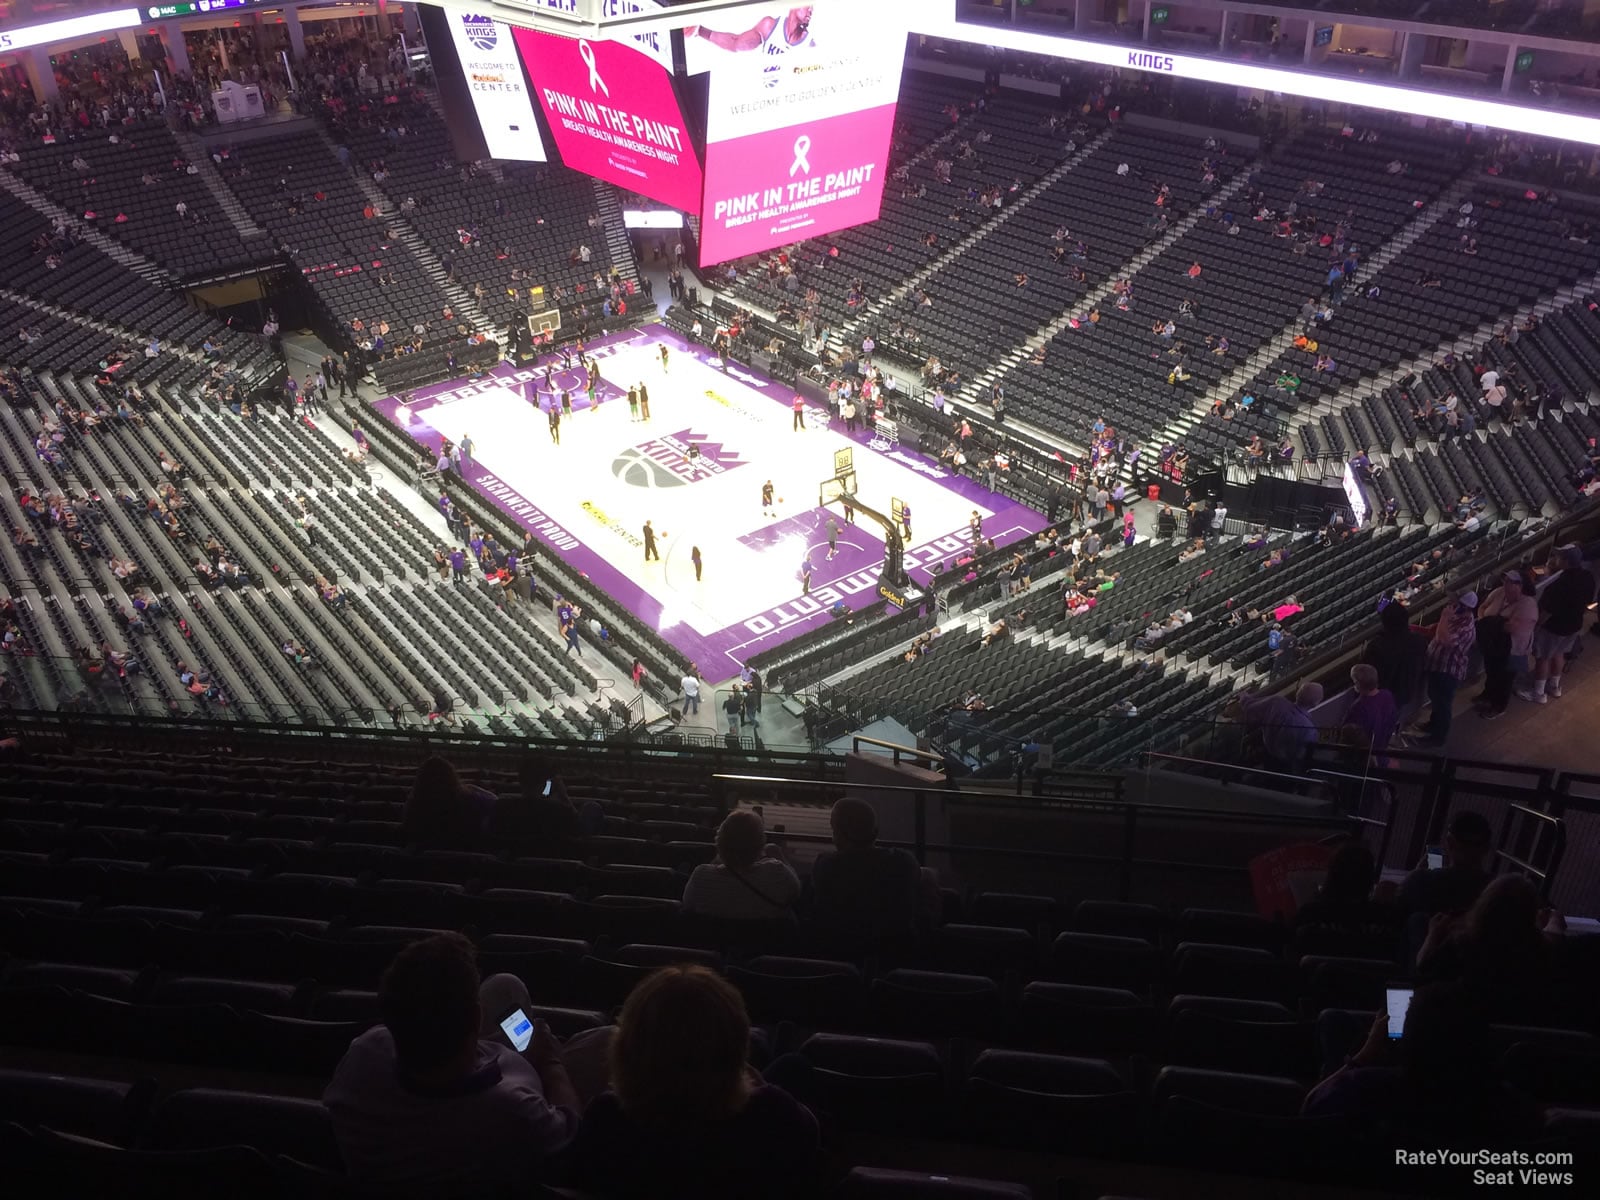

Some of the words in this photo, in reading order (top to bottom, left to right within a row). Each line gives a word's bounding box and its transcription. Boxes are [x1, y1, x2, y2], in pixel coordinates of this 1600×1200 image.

[160, 6, 176, 14] MAC
[465, 28, 497, 37] KINGS
[1128, 52, 1174, 71] KINGS
[473, 83, 521, 92] CENTER
[543, 88, 583, 120] PINK
[579, 98, 601, 126] IN
[597, 104, 634, 137] THE
[631, 114, 683, 153] PAINT
[730, 96, 781, 115] WELCOME
[561, 117, 588, 135] BREAST
[586, 126, 614, 144] HEALTH
[613, 135, 657, 158] AWARENESS
[655, 148, 680, 166] NIGHT
[714, 192, 760, 220] PINK
[763, 186, 783, 208] IN
[786, 177, 822, 201] THE
[824, 163, 875, 192] PAINT
[725, 211, 758, 229] BREAST
[758, 204, 789, 221] HEALTH
[789, 193, 837, 213] AWARENESS
[838, 185, 862, 200] NIGHT
[635, 440, 713, 483] KINGS
[475, 474, 547, 525] SACRAMENTO
[535, 521, 580, 551] PROUD
[880, 586, 901, 605] Golden
